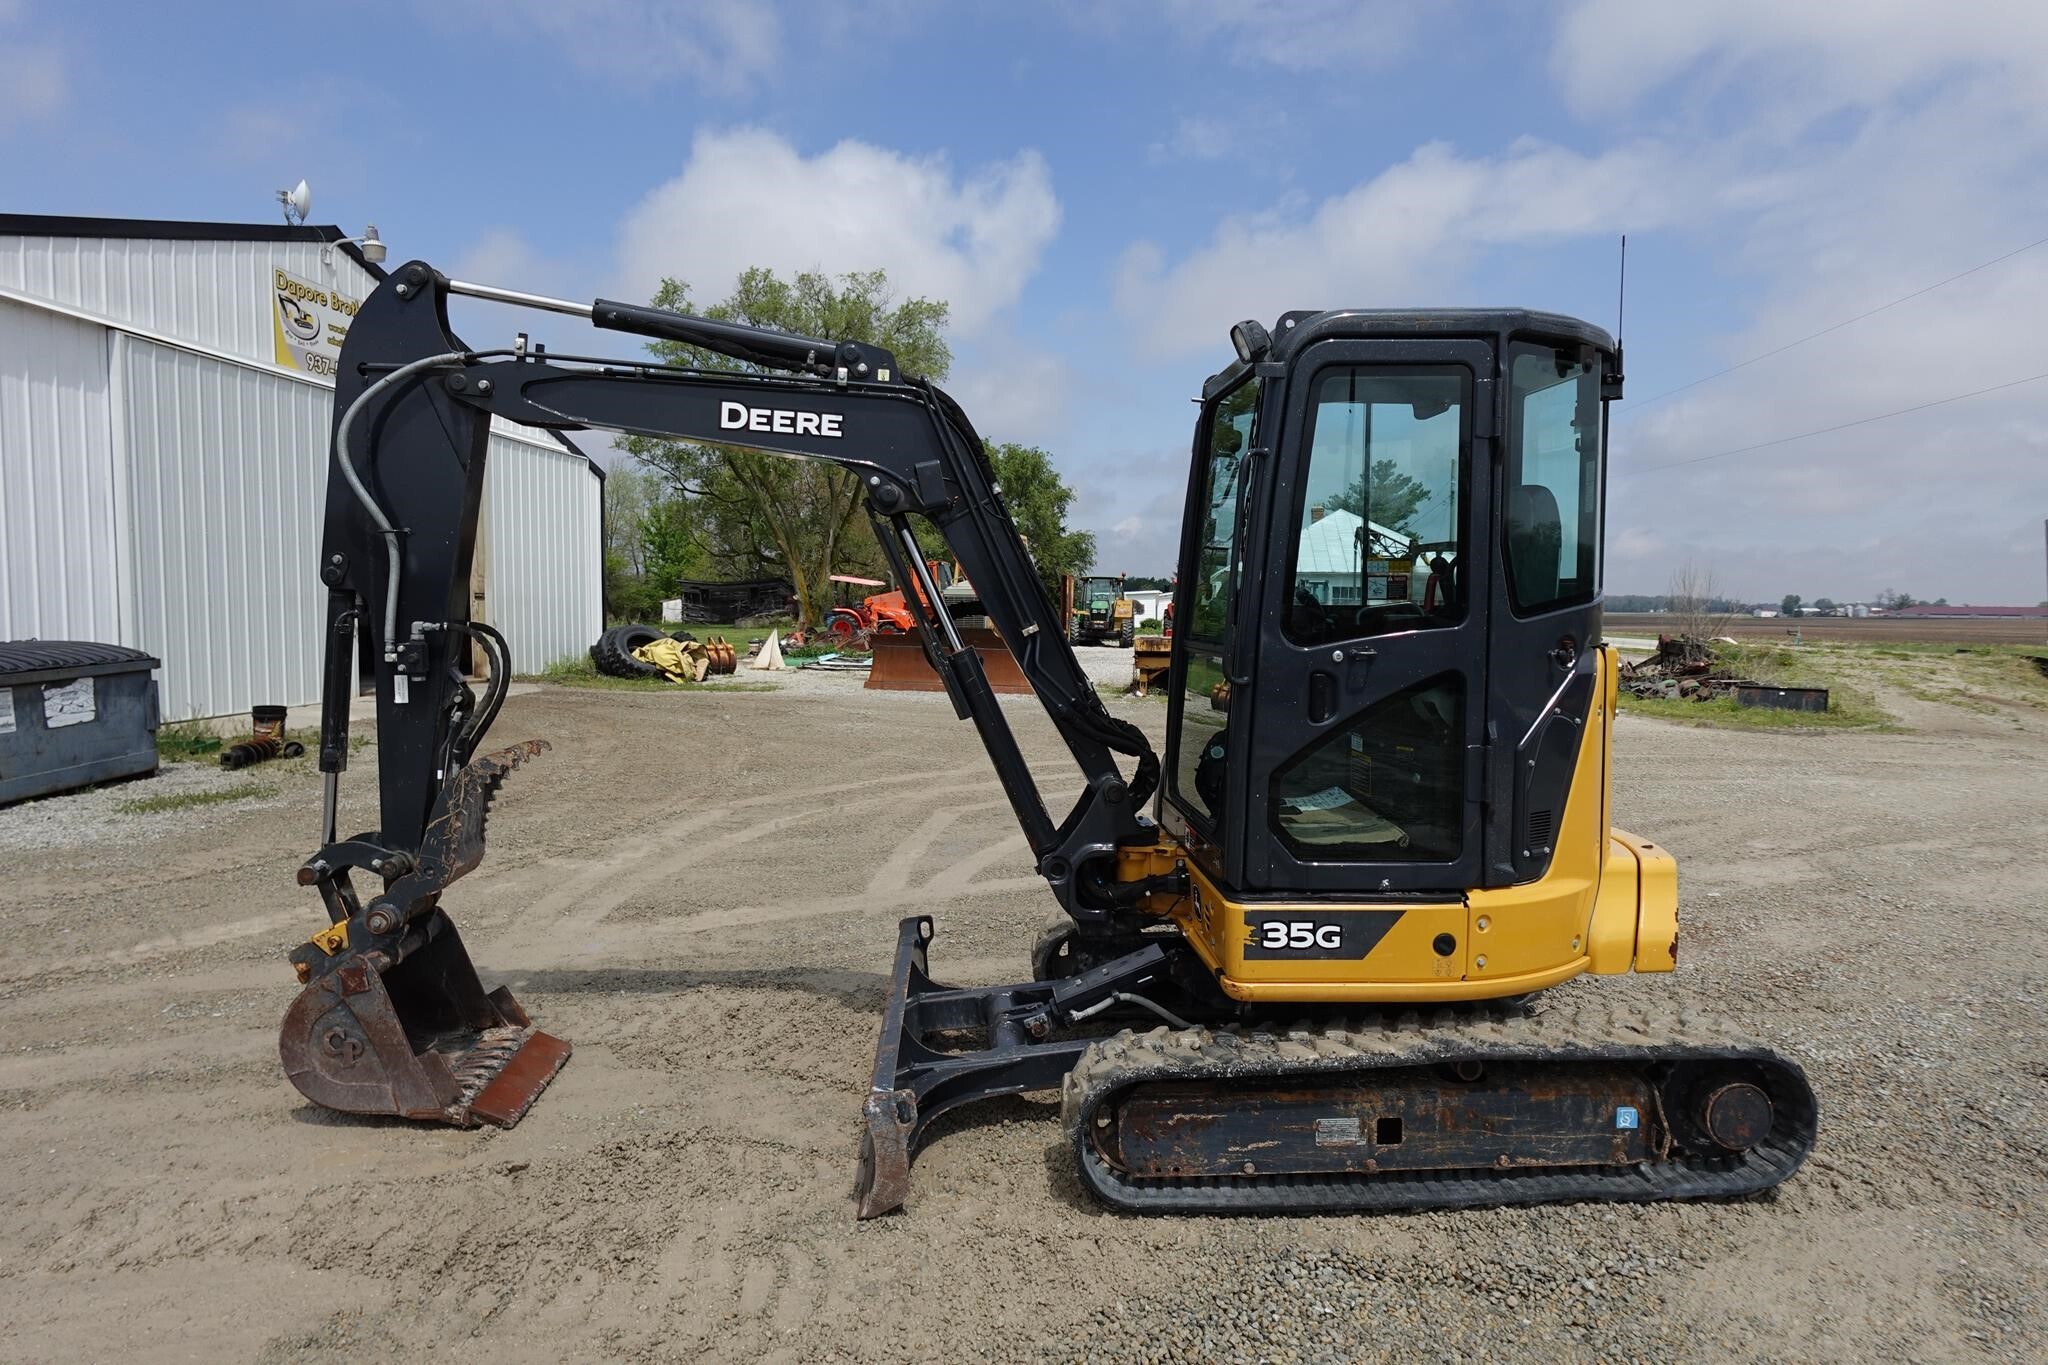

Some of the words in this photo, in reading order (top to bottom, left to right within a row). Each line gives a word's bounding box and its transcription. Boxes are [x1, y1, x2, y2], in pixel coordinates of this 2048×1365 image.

[275, 269, 328, 307] Dapore
[305, 352, 338, 376] 937-
[720, 400, 844, 438] DEERE
[1262, 921, 1342, 949] 35G
